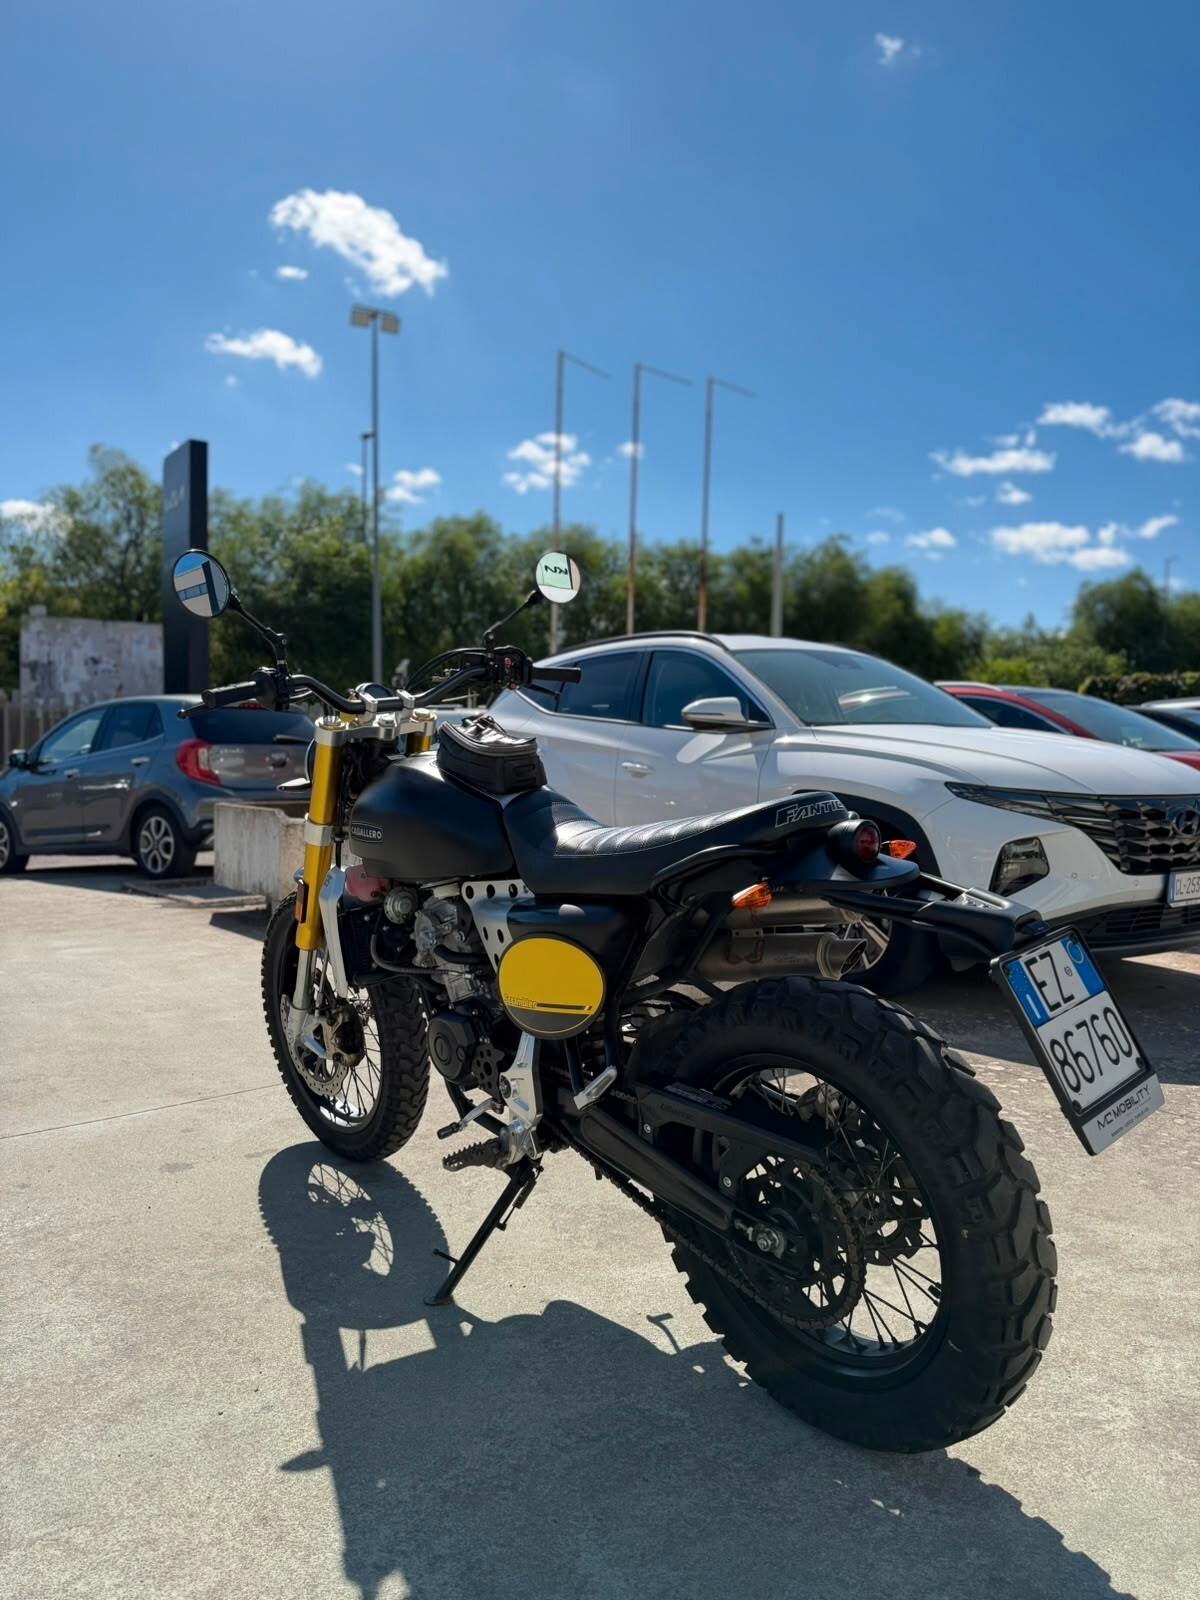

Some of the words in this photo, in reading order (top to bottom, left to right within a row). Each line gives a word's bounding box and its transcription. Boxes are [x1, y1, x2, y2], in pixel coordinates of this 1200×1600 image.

[1024, 951, 1075, 1012] EZ
[1050, 1006, 1133, 1094] 86760
[1112, 1084, 1150, 1120] MOBILITY
